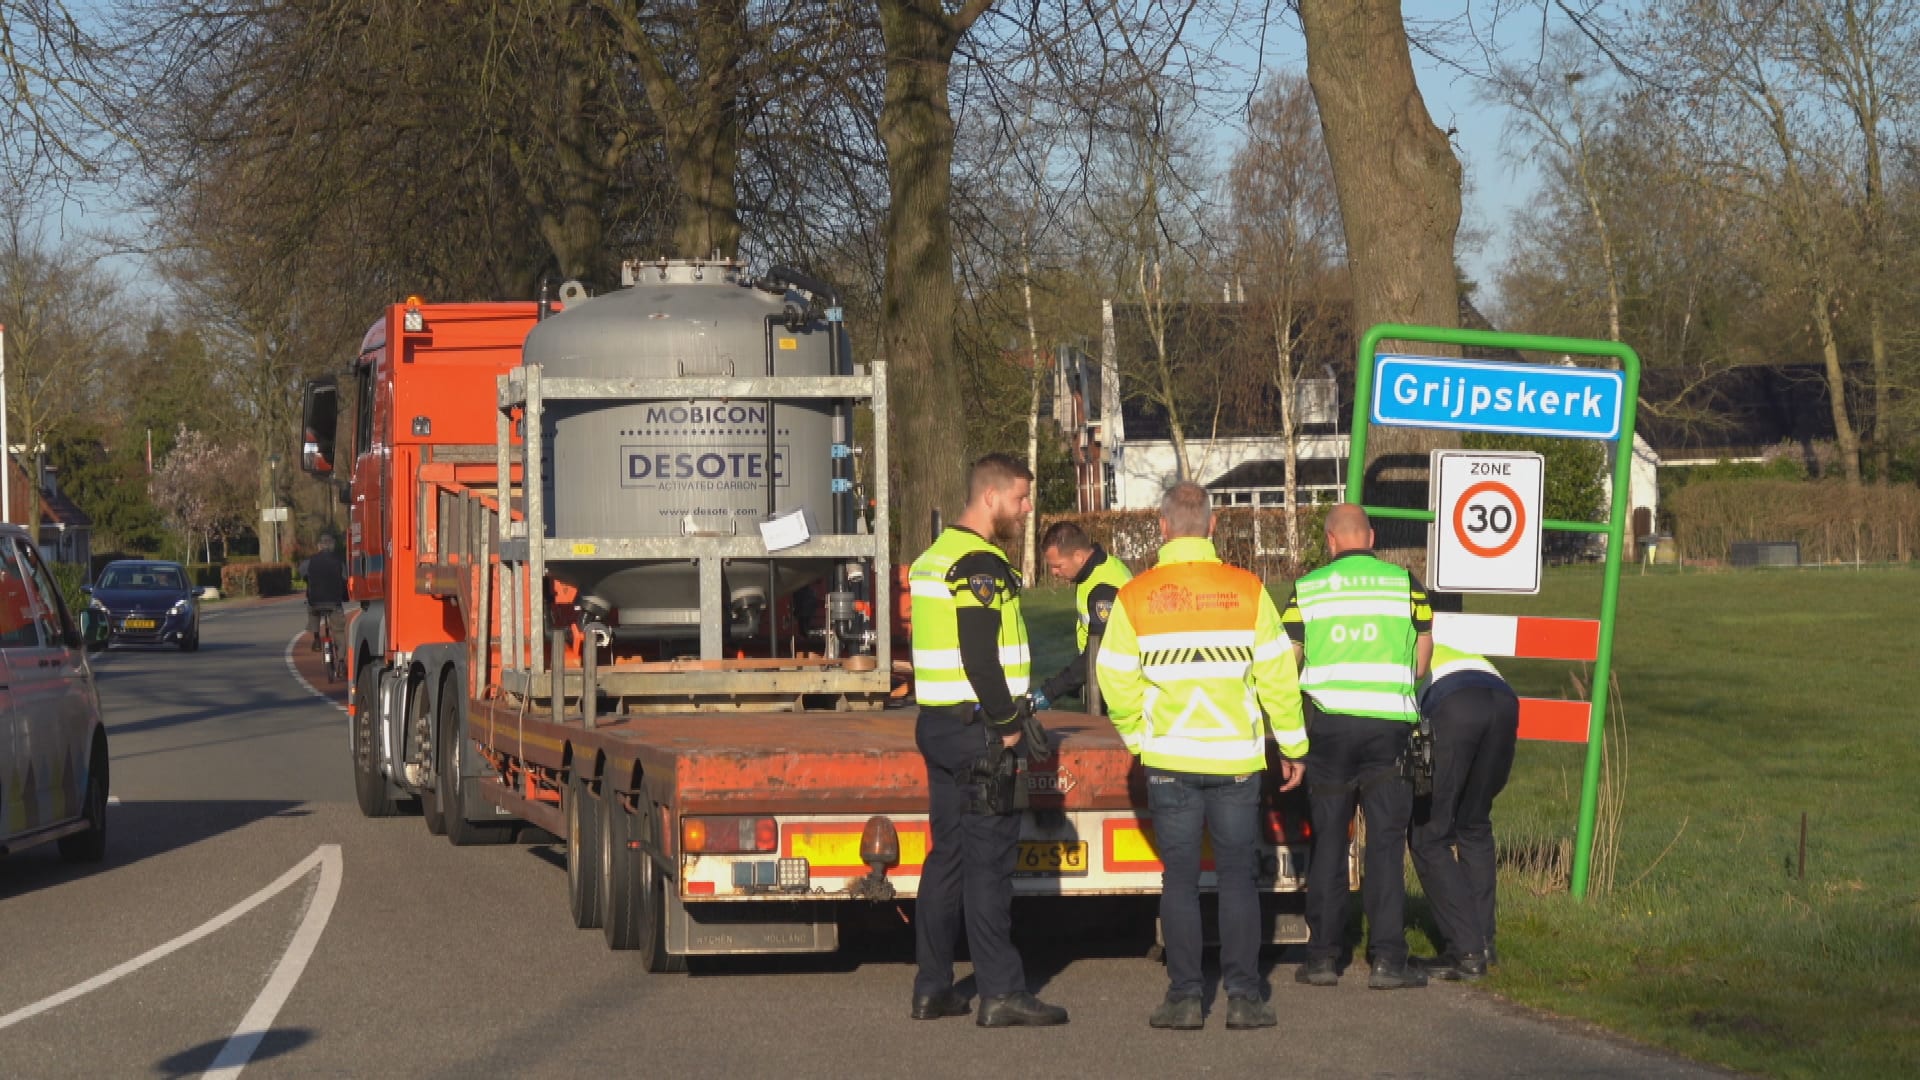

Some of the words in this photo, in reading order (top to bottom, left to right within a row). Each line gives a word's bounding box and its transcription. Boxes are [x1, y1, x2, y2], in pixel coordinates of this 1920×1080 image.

[1393, 373, 1603, 418] Grijpskerk
[646, 406, 765, 424] MOBICON
[629, 453, 783, 480] DESOTEC
[1470, 462, 1512, 476] ZONE
[658, 480, 714, 491] ACTIVATED
[716, 480, 758, 490] CARBON
[658, 507, 758, 516] www.desote.com
[1466, 504, 1513, 534] 30
[1331, 623, 1379, 643] OvD
